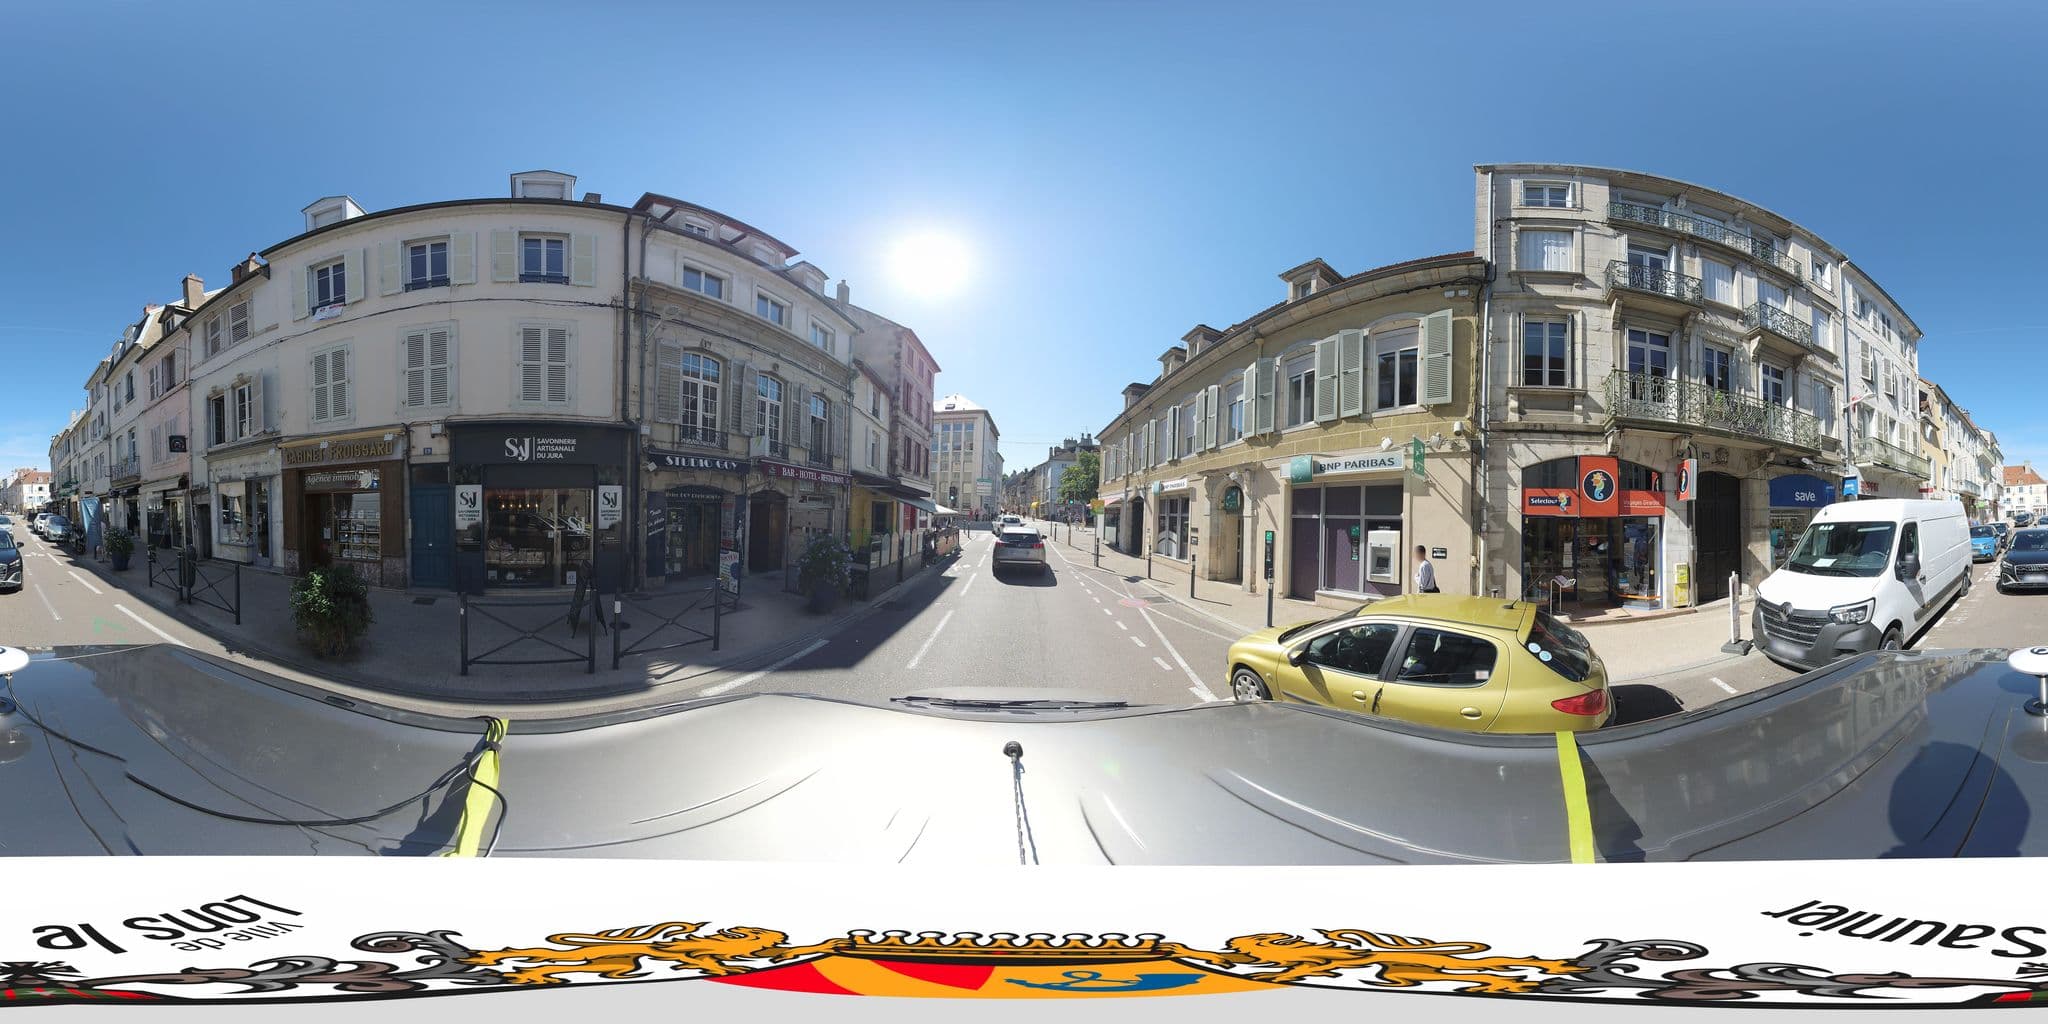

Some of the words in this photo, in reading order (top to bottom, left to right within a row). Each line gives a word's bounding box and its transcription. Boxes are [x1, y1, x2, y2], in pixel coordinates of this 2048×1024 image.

[286, 448, 325, 465] CABINET
[328, 440, 394, 460] FROISSARD
[665, 455, 713, 468] STUDIO
[715, 460, 738, 470] GUY
[1320, 461, 1341, 472] BNP
[1344, 457, 1395, 469] PARIBAS
[305, 474, 331, 485] Agence
[782, 466, 795, 477] BAR
[799, 470, 818, 480] HOTEL
[1794, 491, 1816, 502] save
